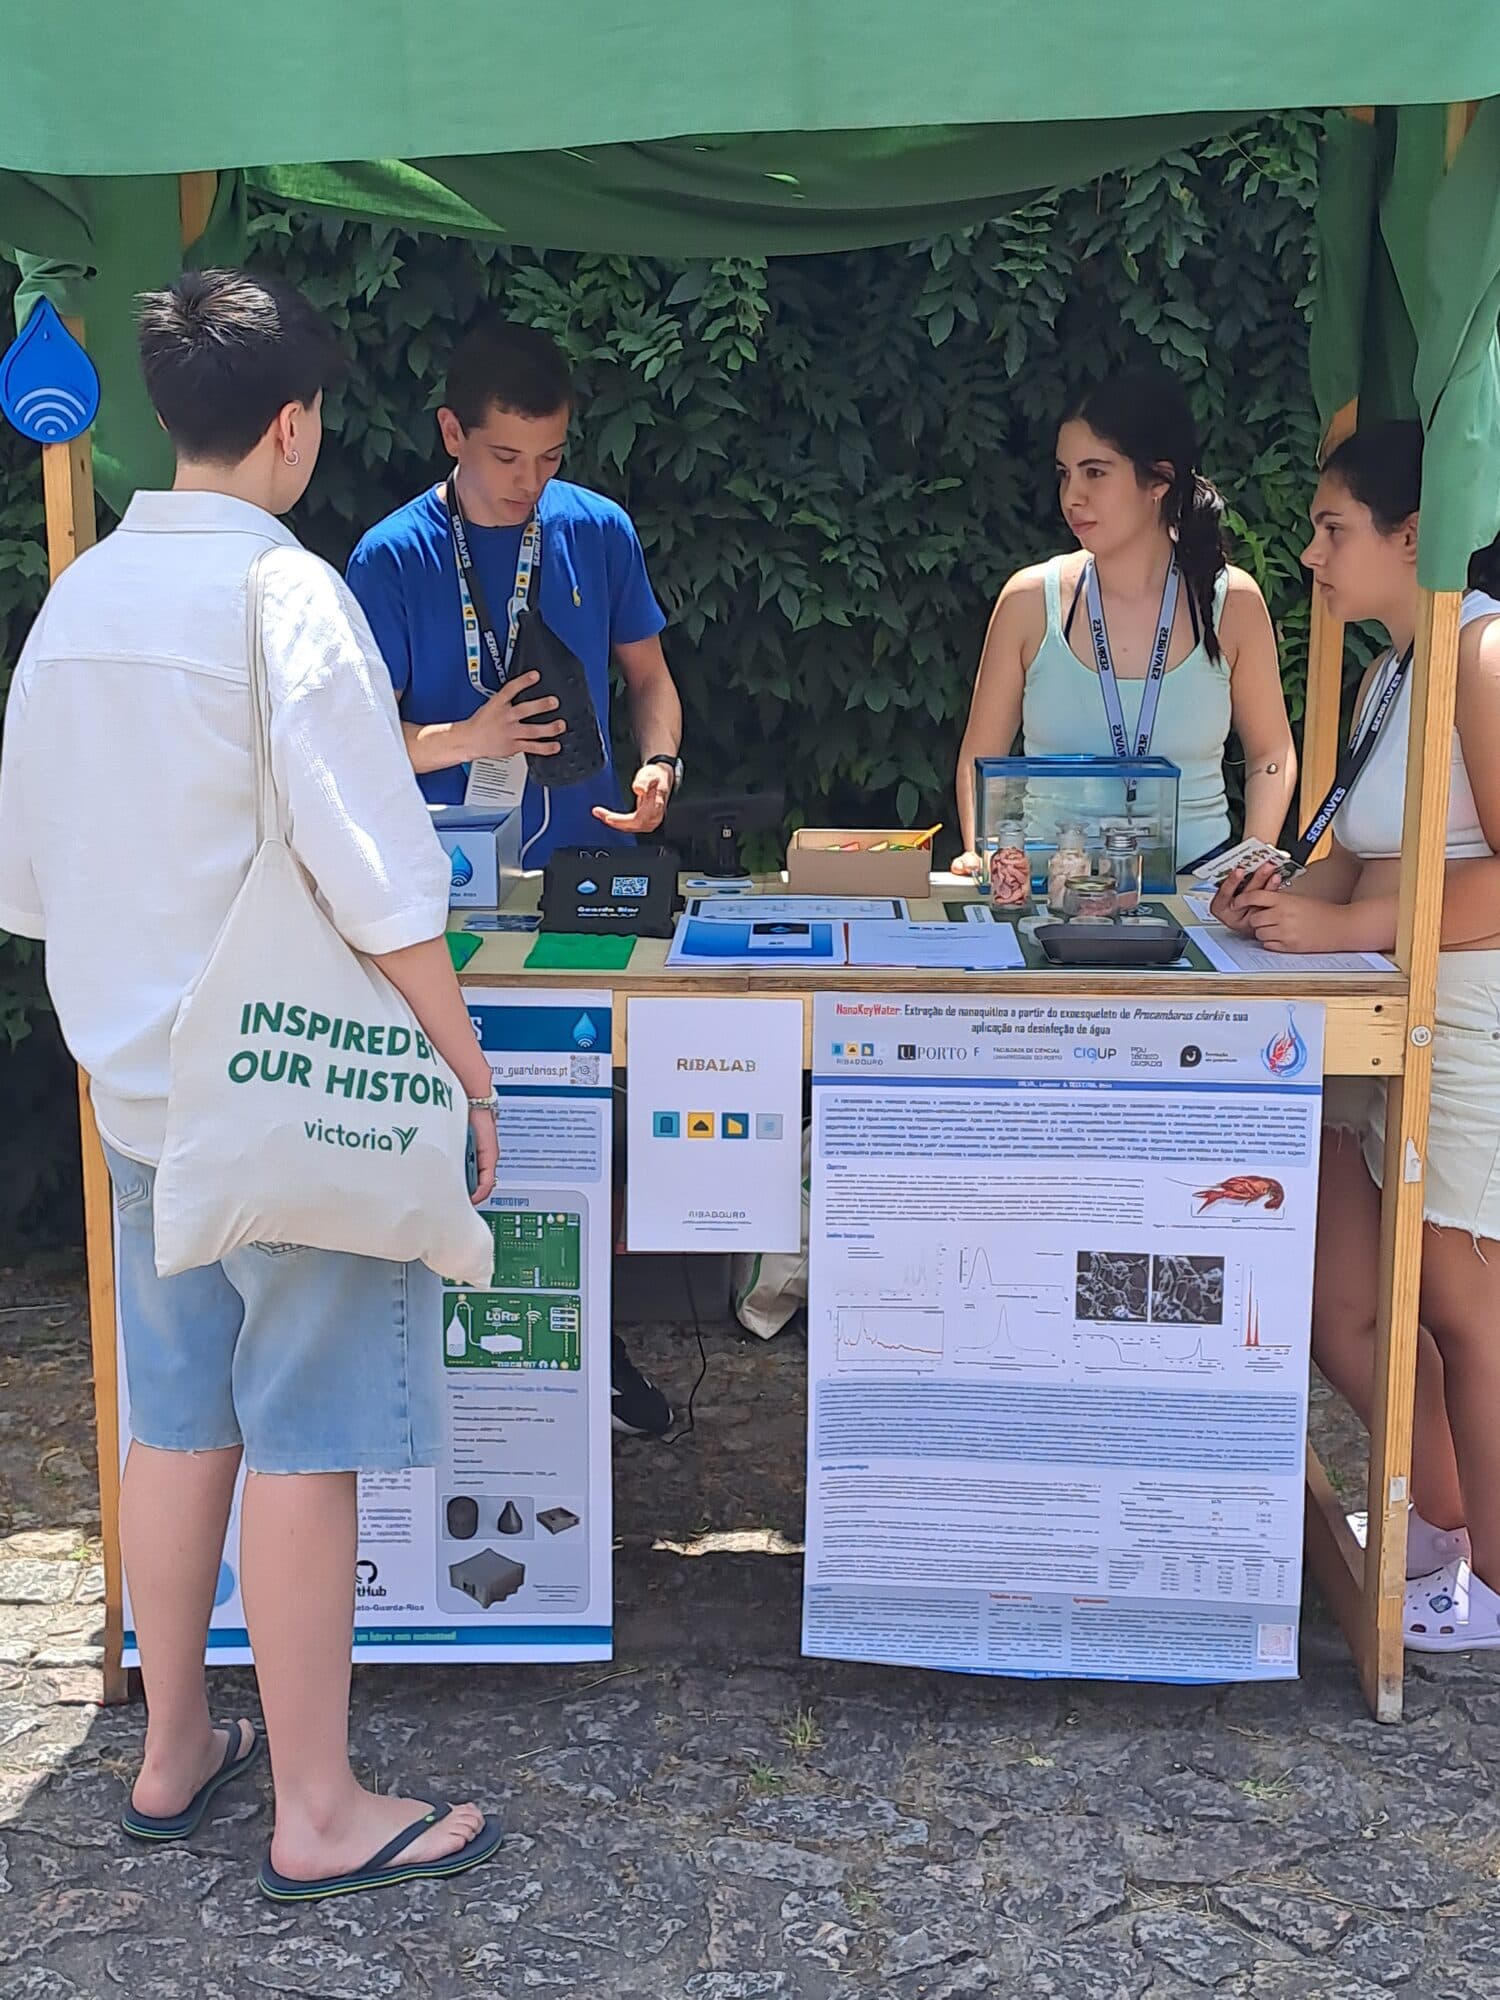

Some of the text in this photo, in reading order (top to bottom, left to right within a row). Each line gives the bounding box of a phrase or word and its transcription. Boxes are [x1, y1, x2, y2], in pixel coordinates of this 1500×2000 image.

[904, 1003, 943, 1018] Extração
[945, 1005, 957, 1017] de
[1011, 1009, 1016, 1017] a
[1018, 1006, 1044, 1020] partir
[1047, 1006, 1058, 1018] do
[1120, 1008, 1131, 1019] de
[1225, 1013, 1231, 1021] e
[1233, 1013, 1249, 1021] sua
[240, 1001, 411, 1057] INSPIRED
[971, 1021, 1111, 1037] aplicação na desinfeção de água
[1073, 1047, 1117, 1064] CIQUP
[676, 1058, 756, 1072] RIBALAB
[228, 1049, 453, 1112] OUR HISTORY
[304, 1118, 392, 1152] victoria
[688, 1210, 746, 1220] RIBADOURO
[356, 1585, 387, 1597] tHub
